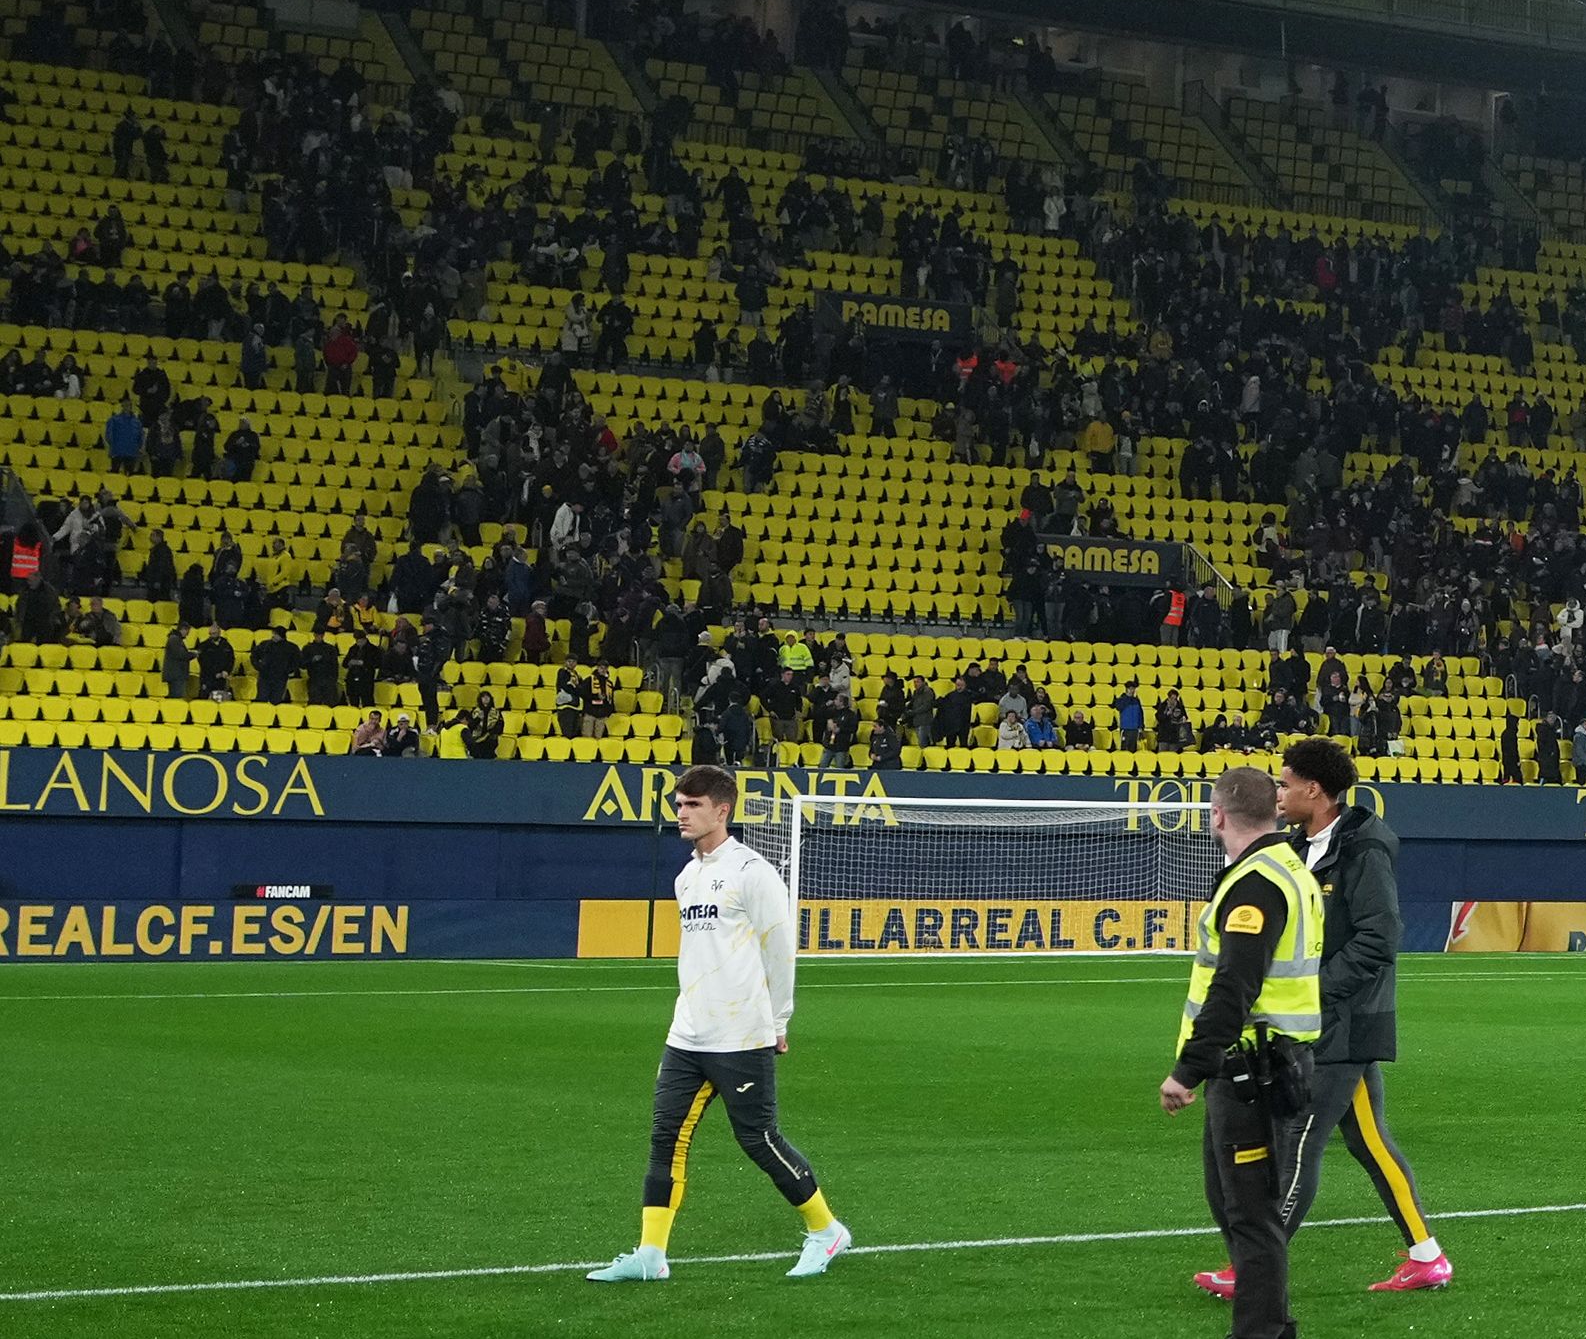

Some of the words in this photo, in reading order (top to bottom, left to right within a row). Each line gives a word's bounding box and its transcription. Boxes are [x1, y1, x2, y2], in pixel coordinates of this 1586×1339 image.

[842, 300, 950, 332] PAMESA
[0, 750, 326, 816] LANOSA
[582, 765, 900, 826] ARENTA
[255, 884, 310, 898] #FANCAM
[0, 905, 409, 957] EALCF.ES/EN
[1093, 907, 1177, 950] C.F.
